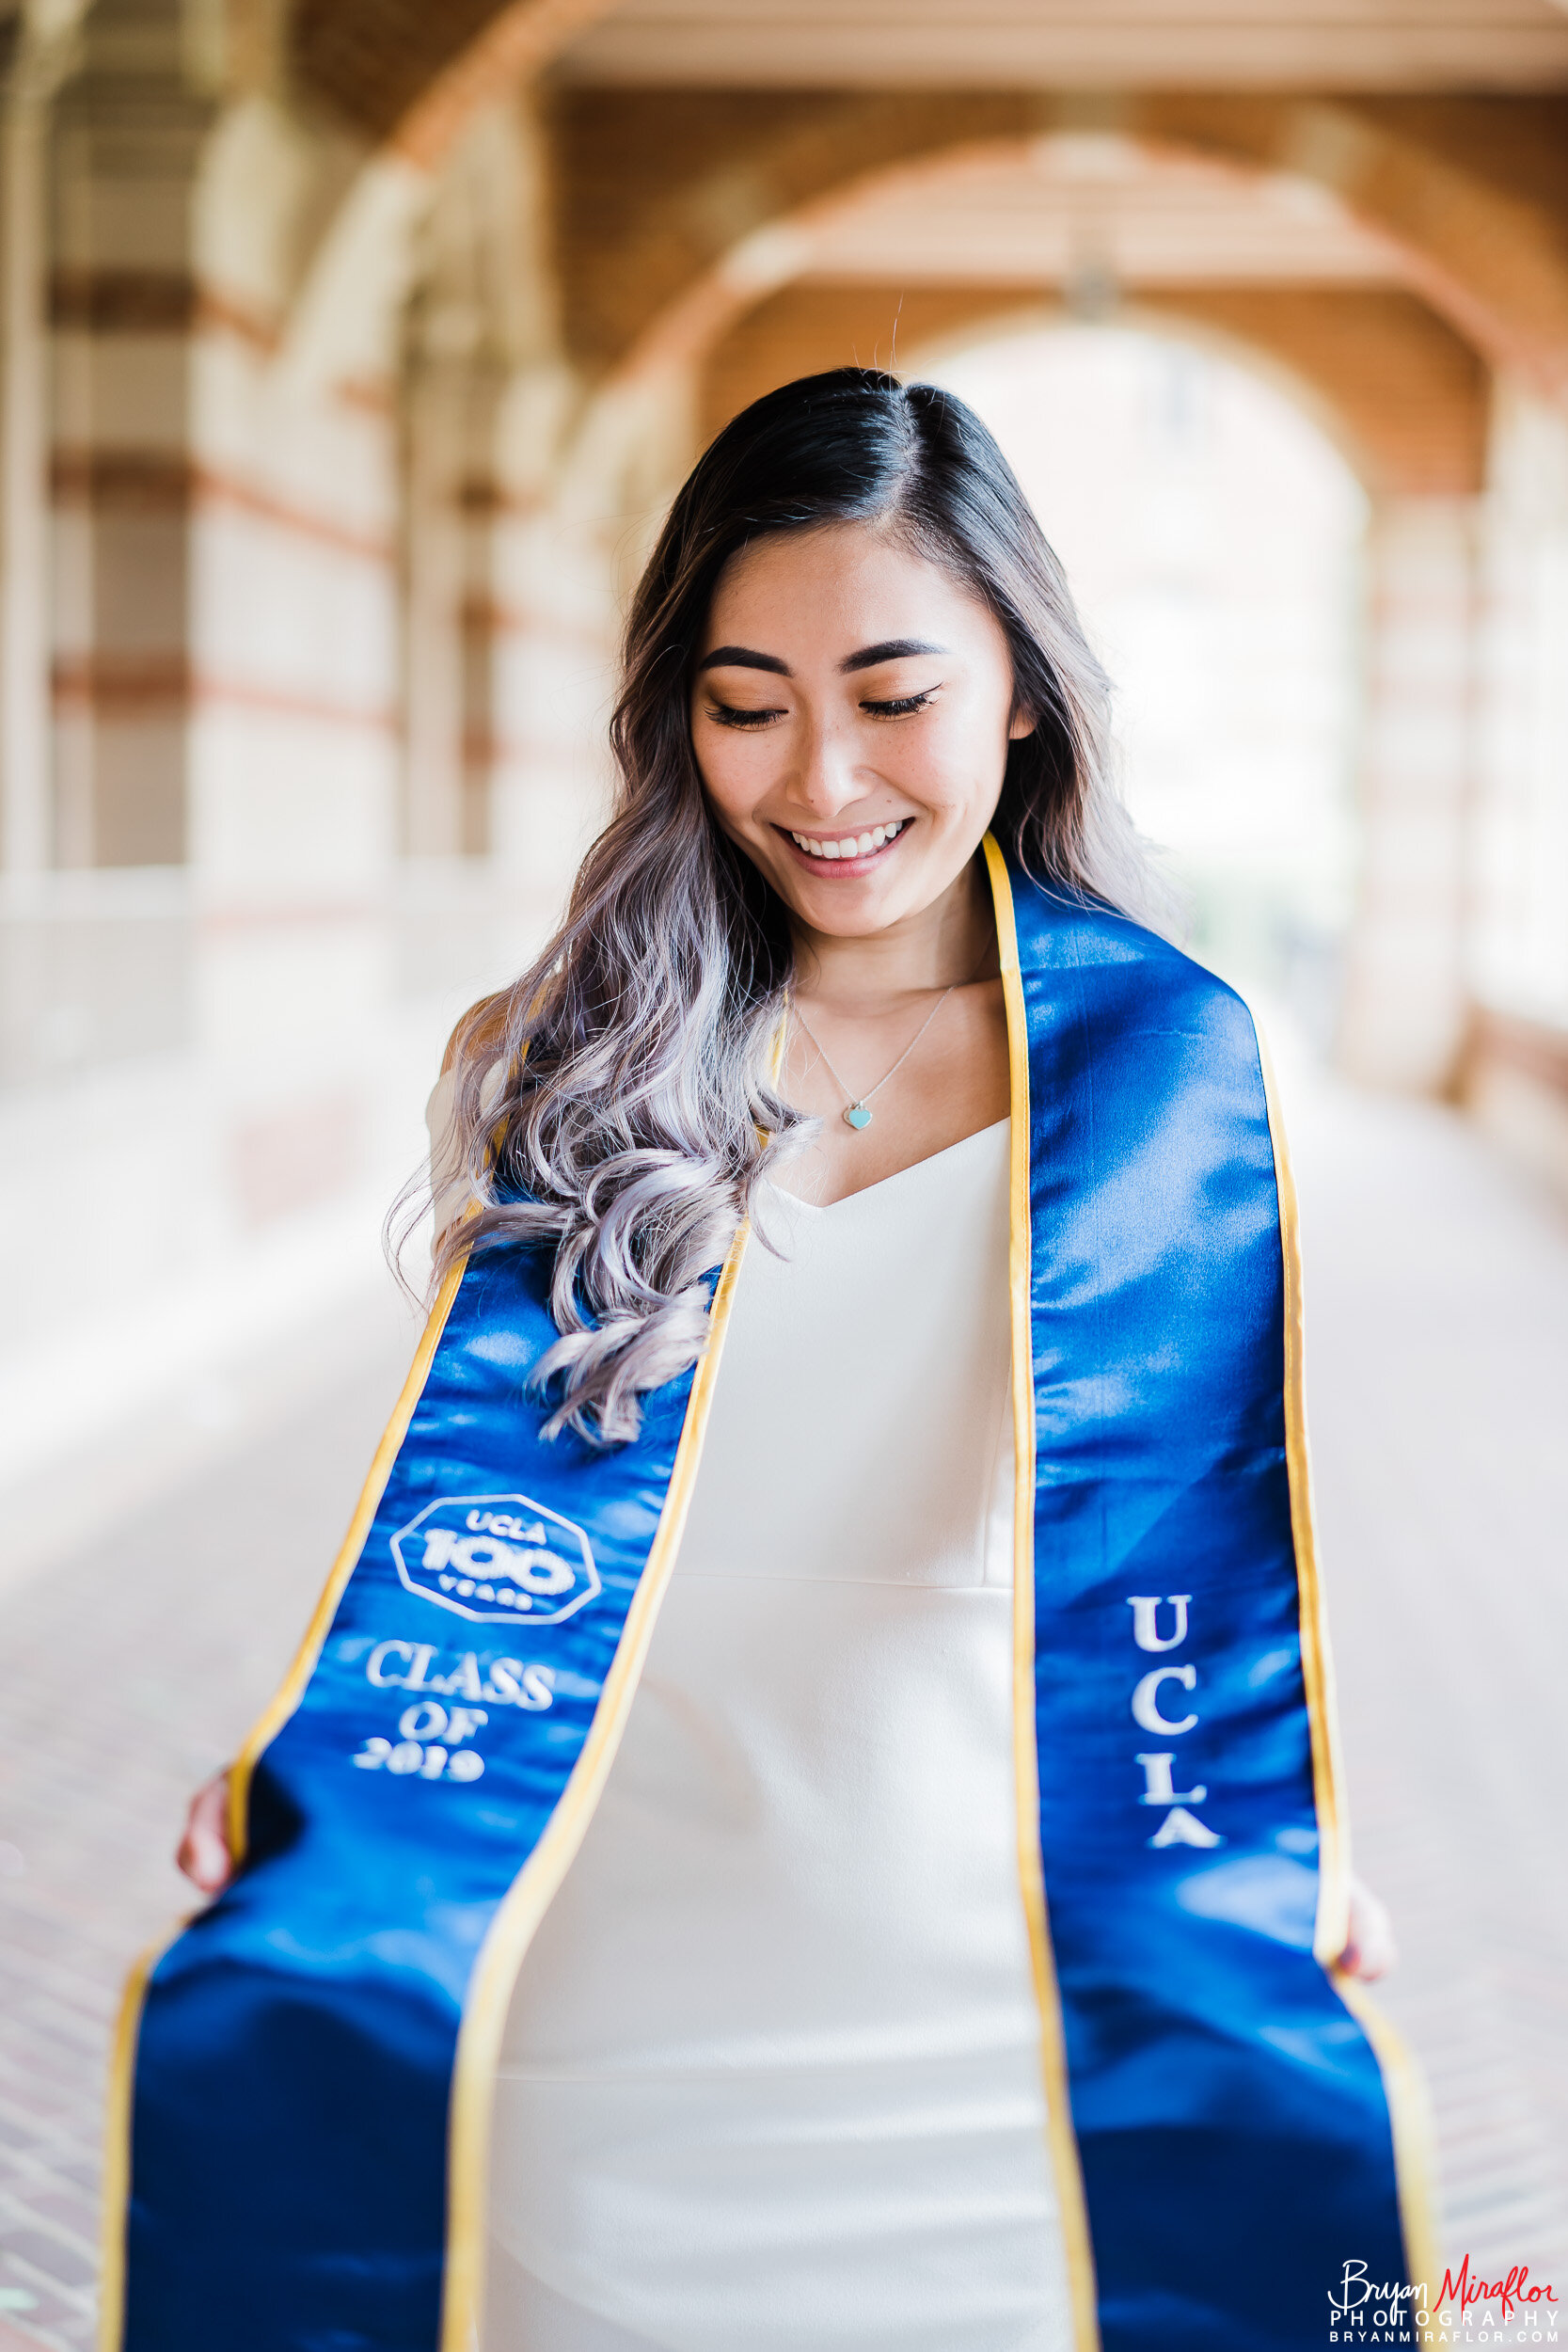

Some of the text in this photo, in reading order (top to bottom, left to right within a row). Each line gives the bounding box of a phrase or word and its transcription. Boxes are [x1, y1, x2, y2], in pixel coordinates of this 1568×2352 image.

[466, 1509, 546, 1545] UCLA
[422, 1528, 576, 1596] 100
[366, 1640, 556, 1711] CLASS
[399, 1701, 489, 1745] OF
[1126, 1594, 1227, 1849] UCLA
[351, 1737, 485, 1783] 2019
